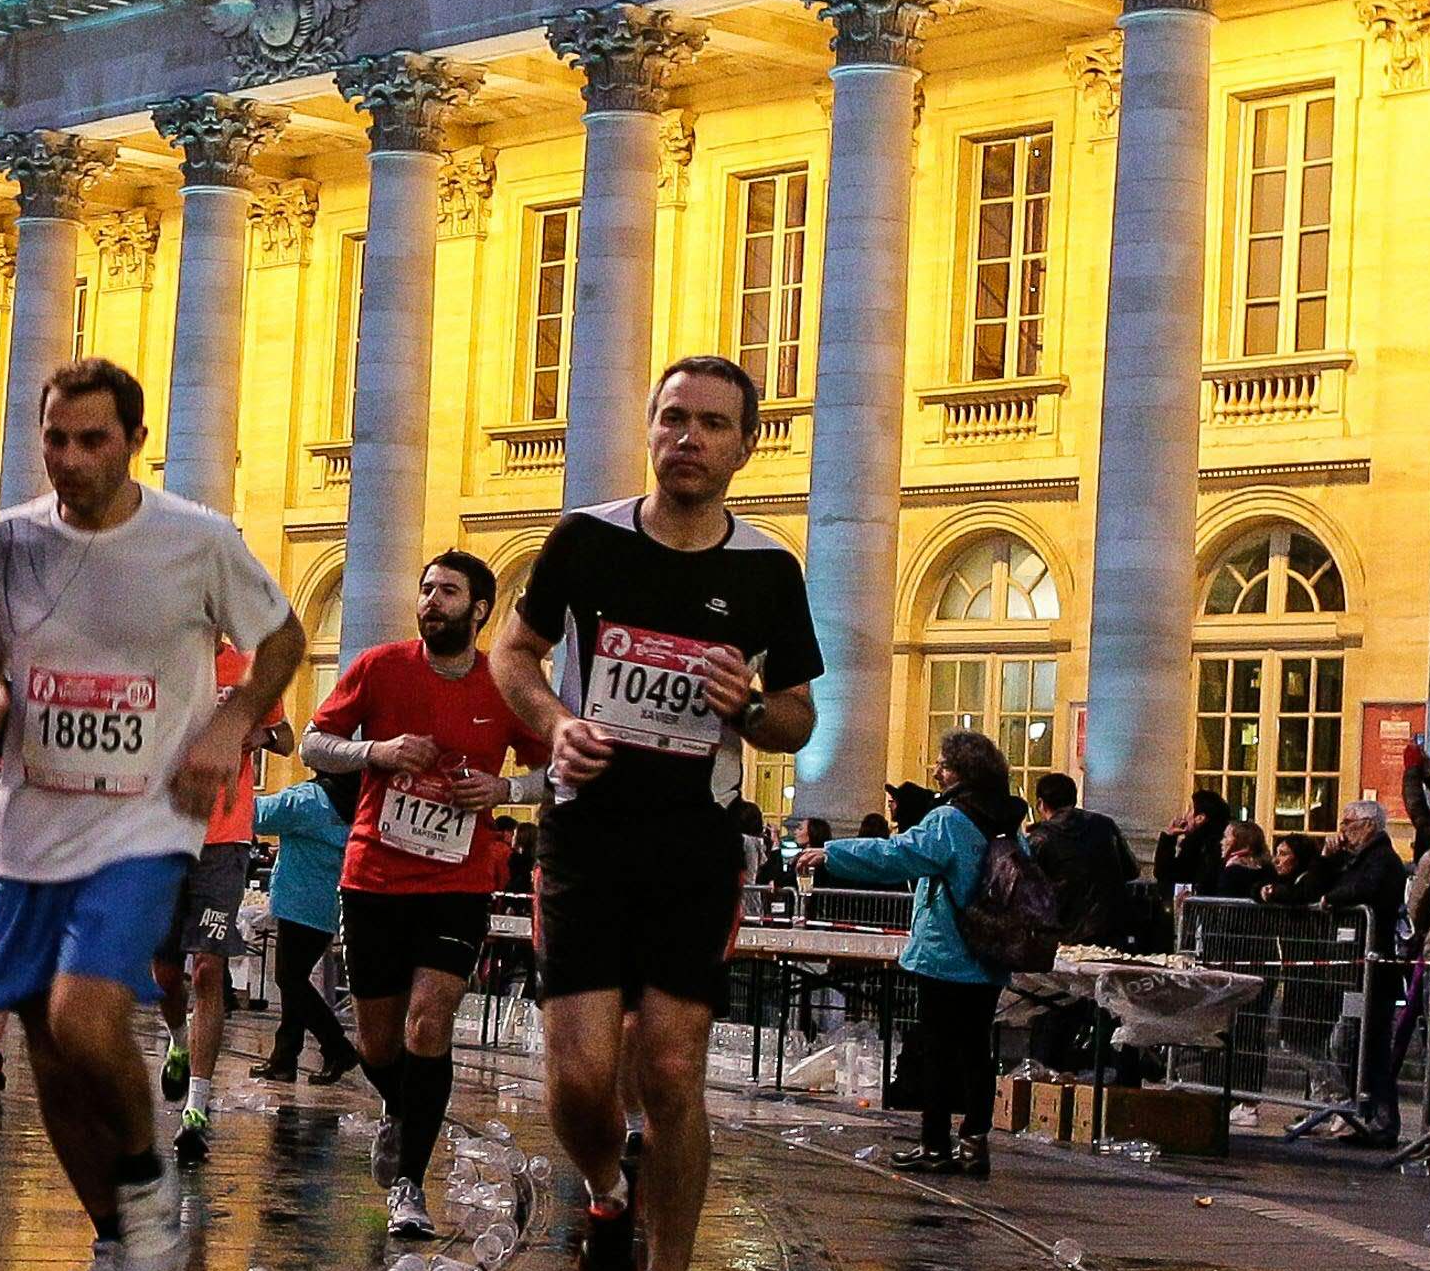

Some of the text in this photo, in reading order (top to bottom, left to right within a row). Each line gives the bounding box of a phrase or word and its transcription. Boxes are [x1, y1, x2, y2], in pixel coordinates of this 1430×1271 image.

[591, 703, 602, 717] F
[39, 707, 143, 754] 18853
[395, 795, 467, 837] 11721
[207, 923, 227, 940] 76
